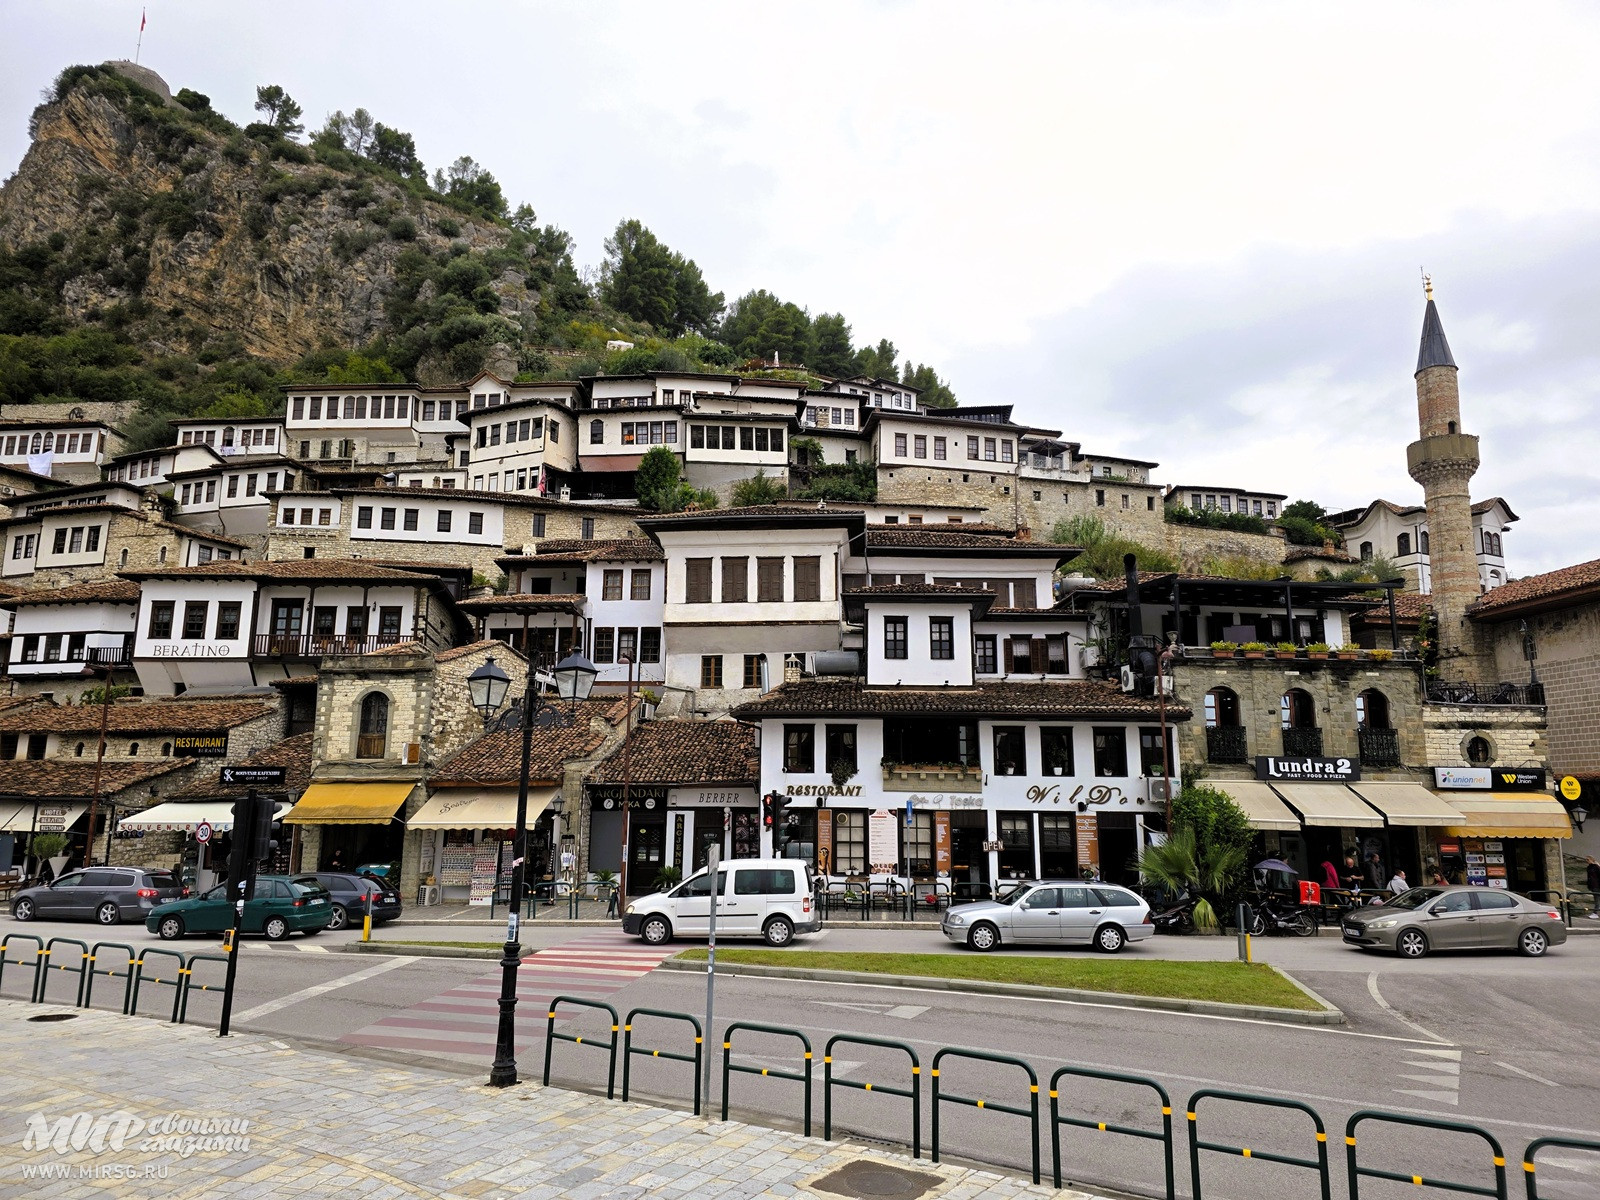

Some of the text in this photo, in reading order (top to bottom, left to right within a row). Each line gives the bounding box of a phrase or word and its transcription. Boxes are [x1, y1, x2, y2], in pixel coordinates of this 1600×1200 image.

[153, 643, 230, 656] BERATINO
[175, 737, 227, 748] RESTAURANT
[786, 785, 863, 796] RESTORANT
[698, 792, 740, 803] BERBER
[199, 827, 209, 838] 30
[983, 841, 1004, 852] OPEN
